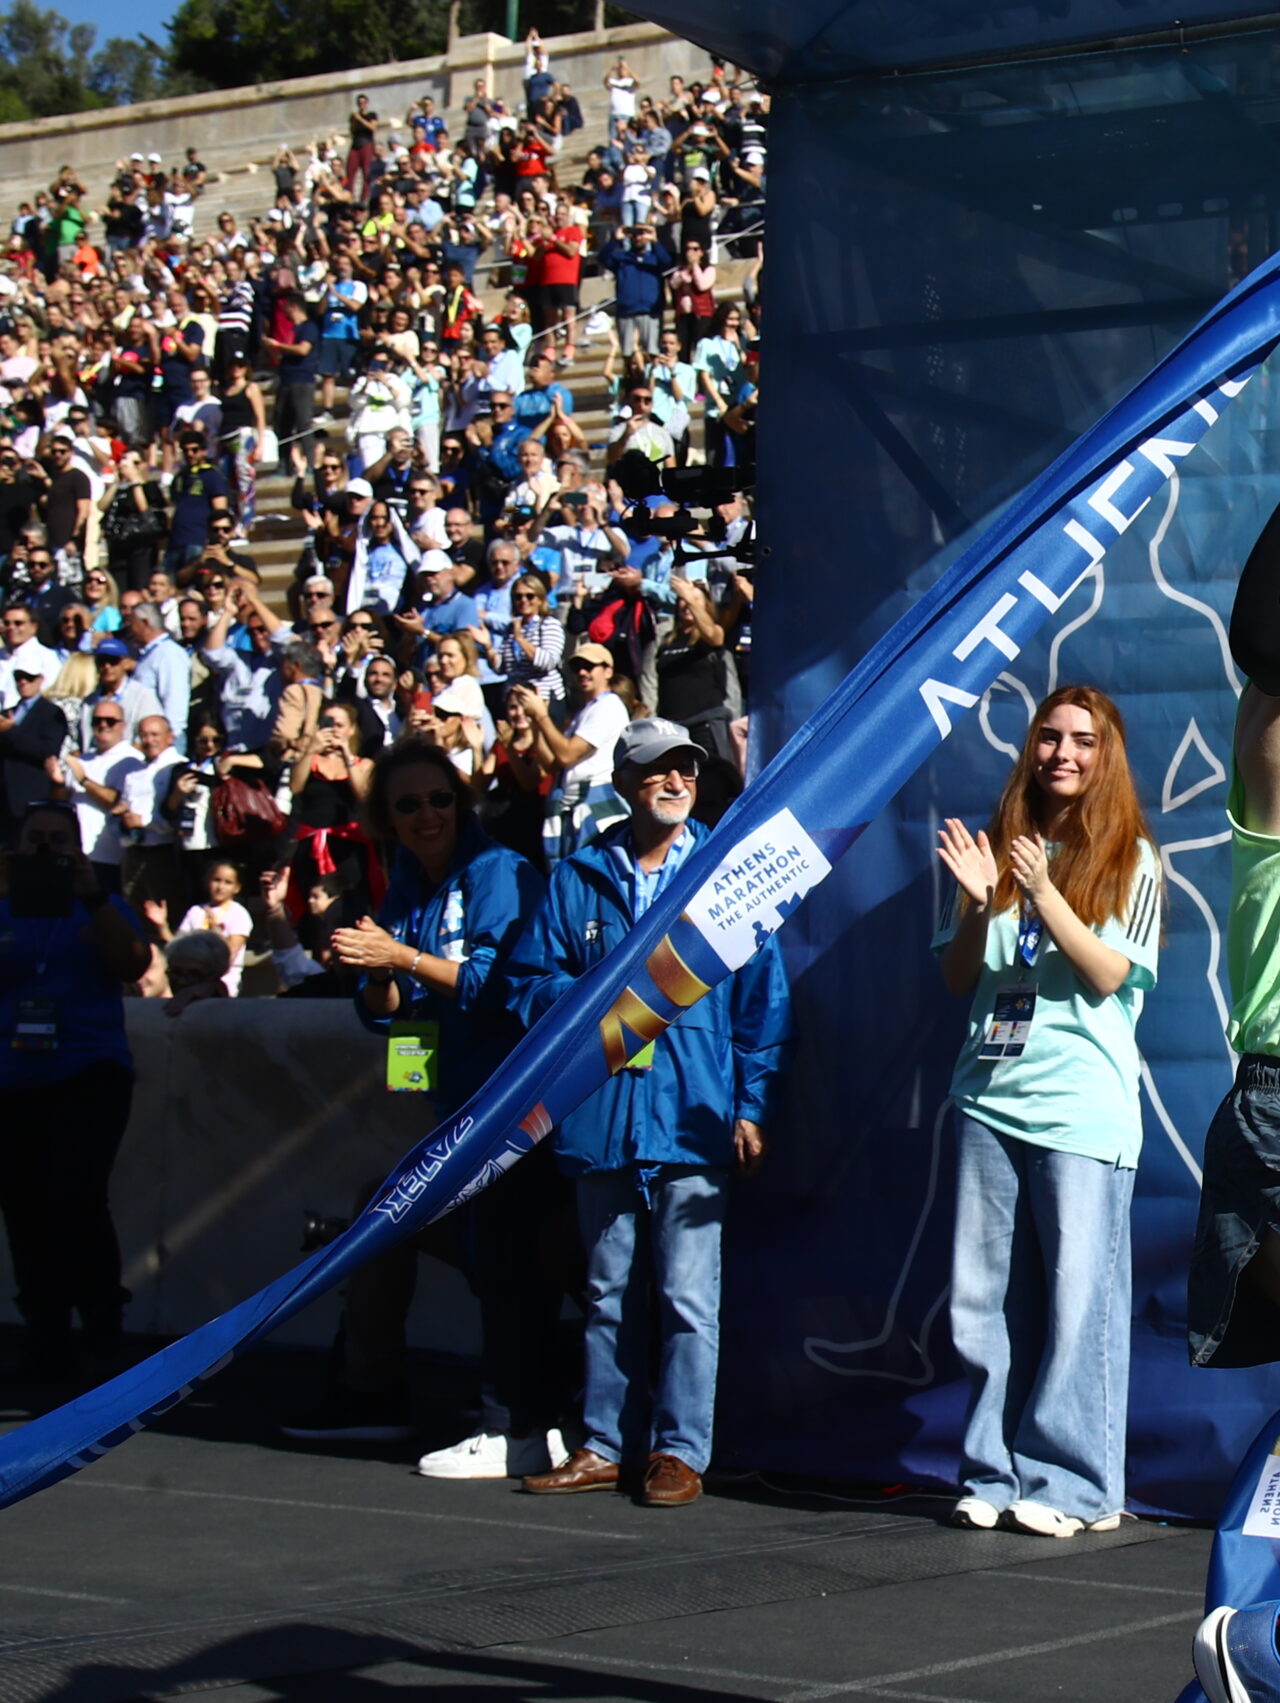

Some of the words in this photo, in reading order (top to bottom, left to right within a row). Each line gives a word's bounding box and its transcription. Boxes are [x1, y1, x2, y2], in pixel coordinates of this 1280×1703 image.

[707, 845, 801, 921] MARATHON
[713, 842, 777, 895] ATHENS
[717, 910, 744, 931] THE
[745, 859, 810, 912] AUTHENTIC
